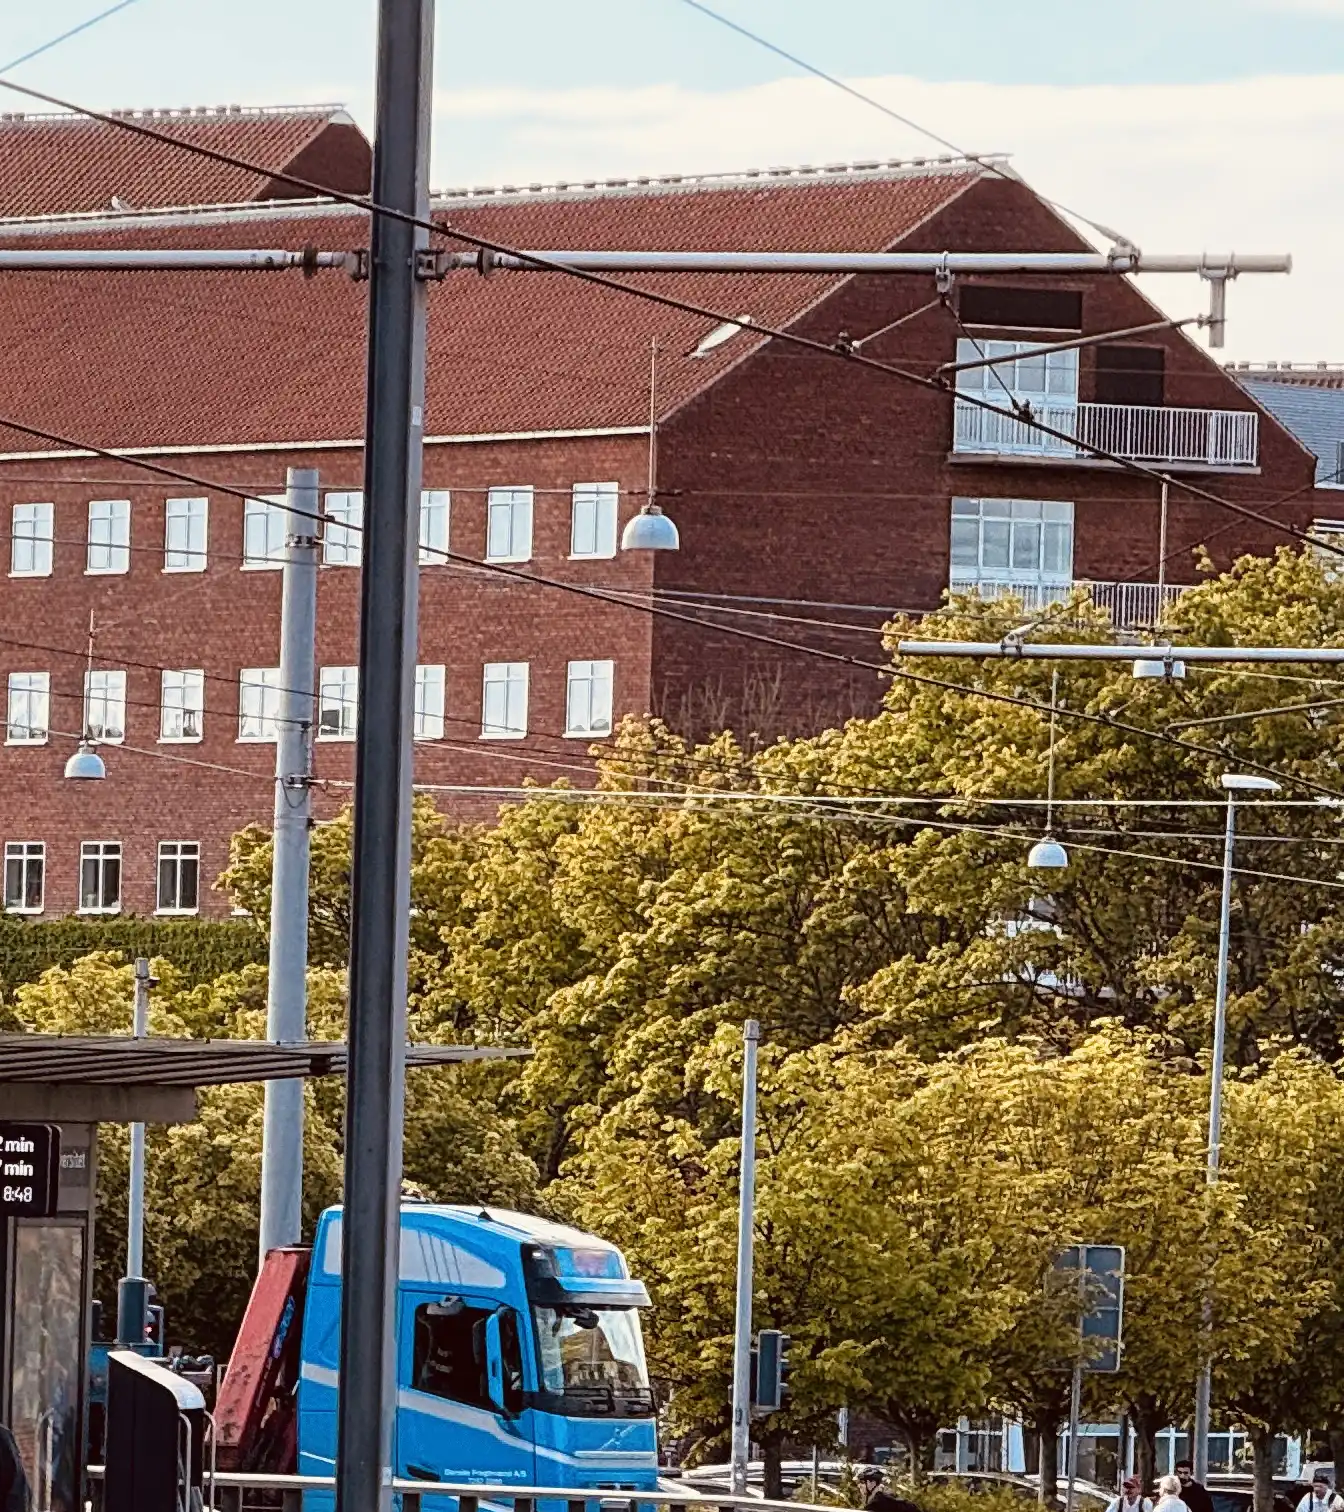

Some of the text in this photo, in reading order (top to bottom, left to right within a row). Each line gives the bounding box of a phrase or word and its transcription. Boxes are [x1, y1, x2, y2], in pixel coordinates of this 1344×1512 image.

[4, 1136, 35, 1153] min
[4, 1159, 34, 1177] min
[3, 1185, 33, 1203] 8:48
